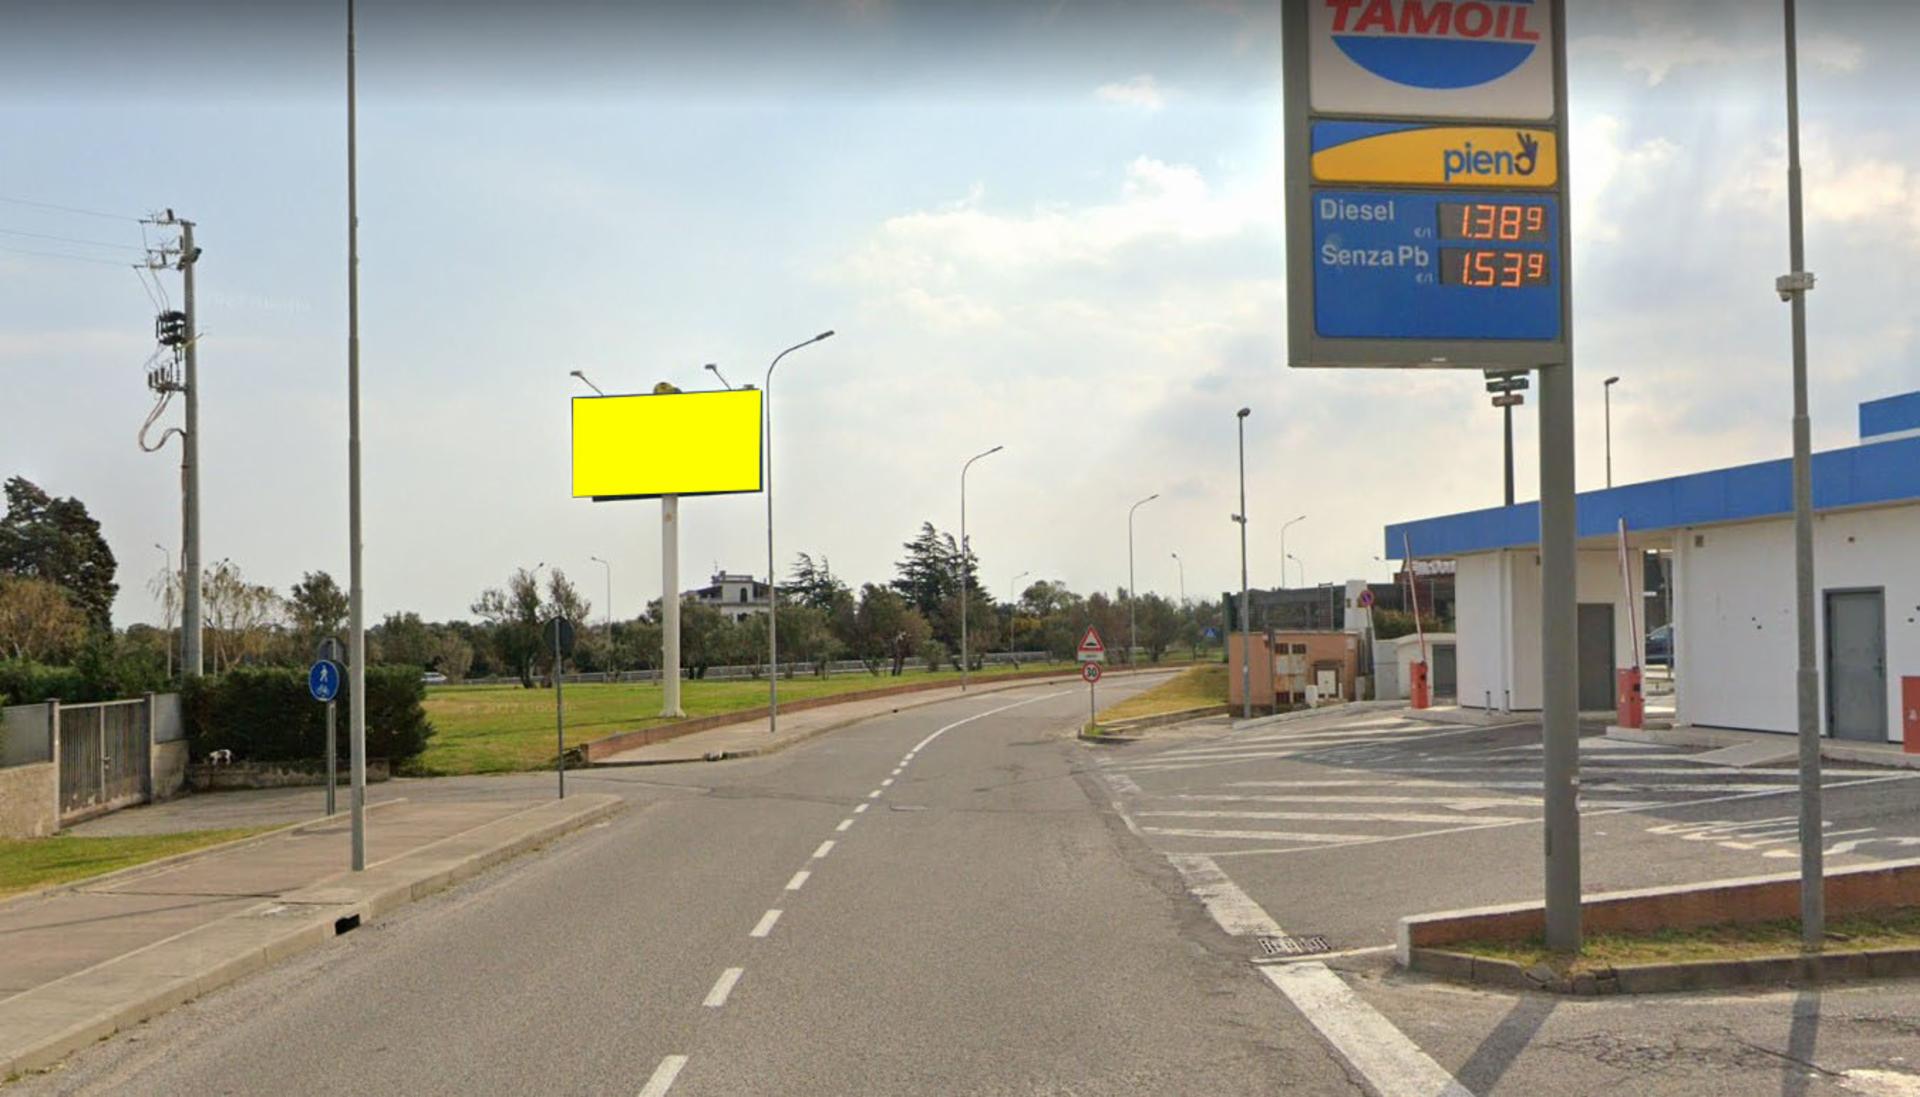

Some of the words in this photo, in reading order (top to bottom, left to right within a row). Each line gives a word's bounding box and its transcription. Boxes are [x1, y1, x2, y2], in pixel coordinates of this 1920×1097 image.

[1325, 0, 1539, 40] TAMOIL
[1443, 140, 1538, 182] pieno
[1320, 199, 1394, 221] Diesel
[1321, 244, 1394, 266] Senza
[1398, 246, 1429, 267] Pb
[1086, 667, 1098, 677] 30
